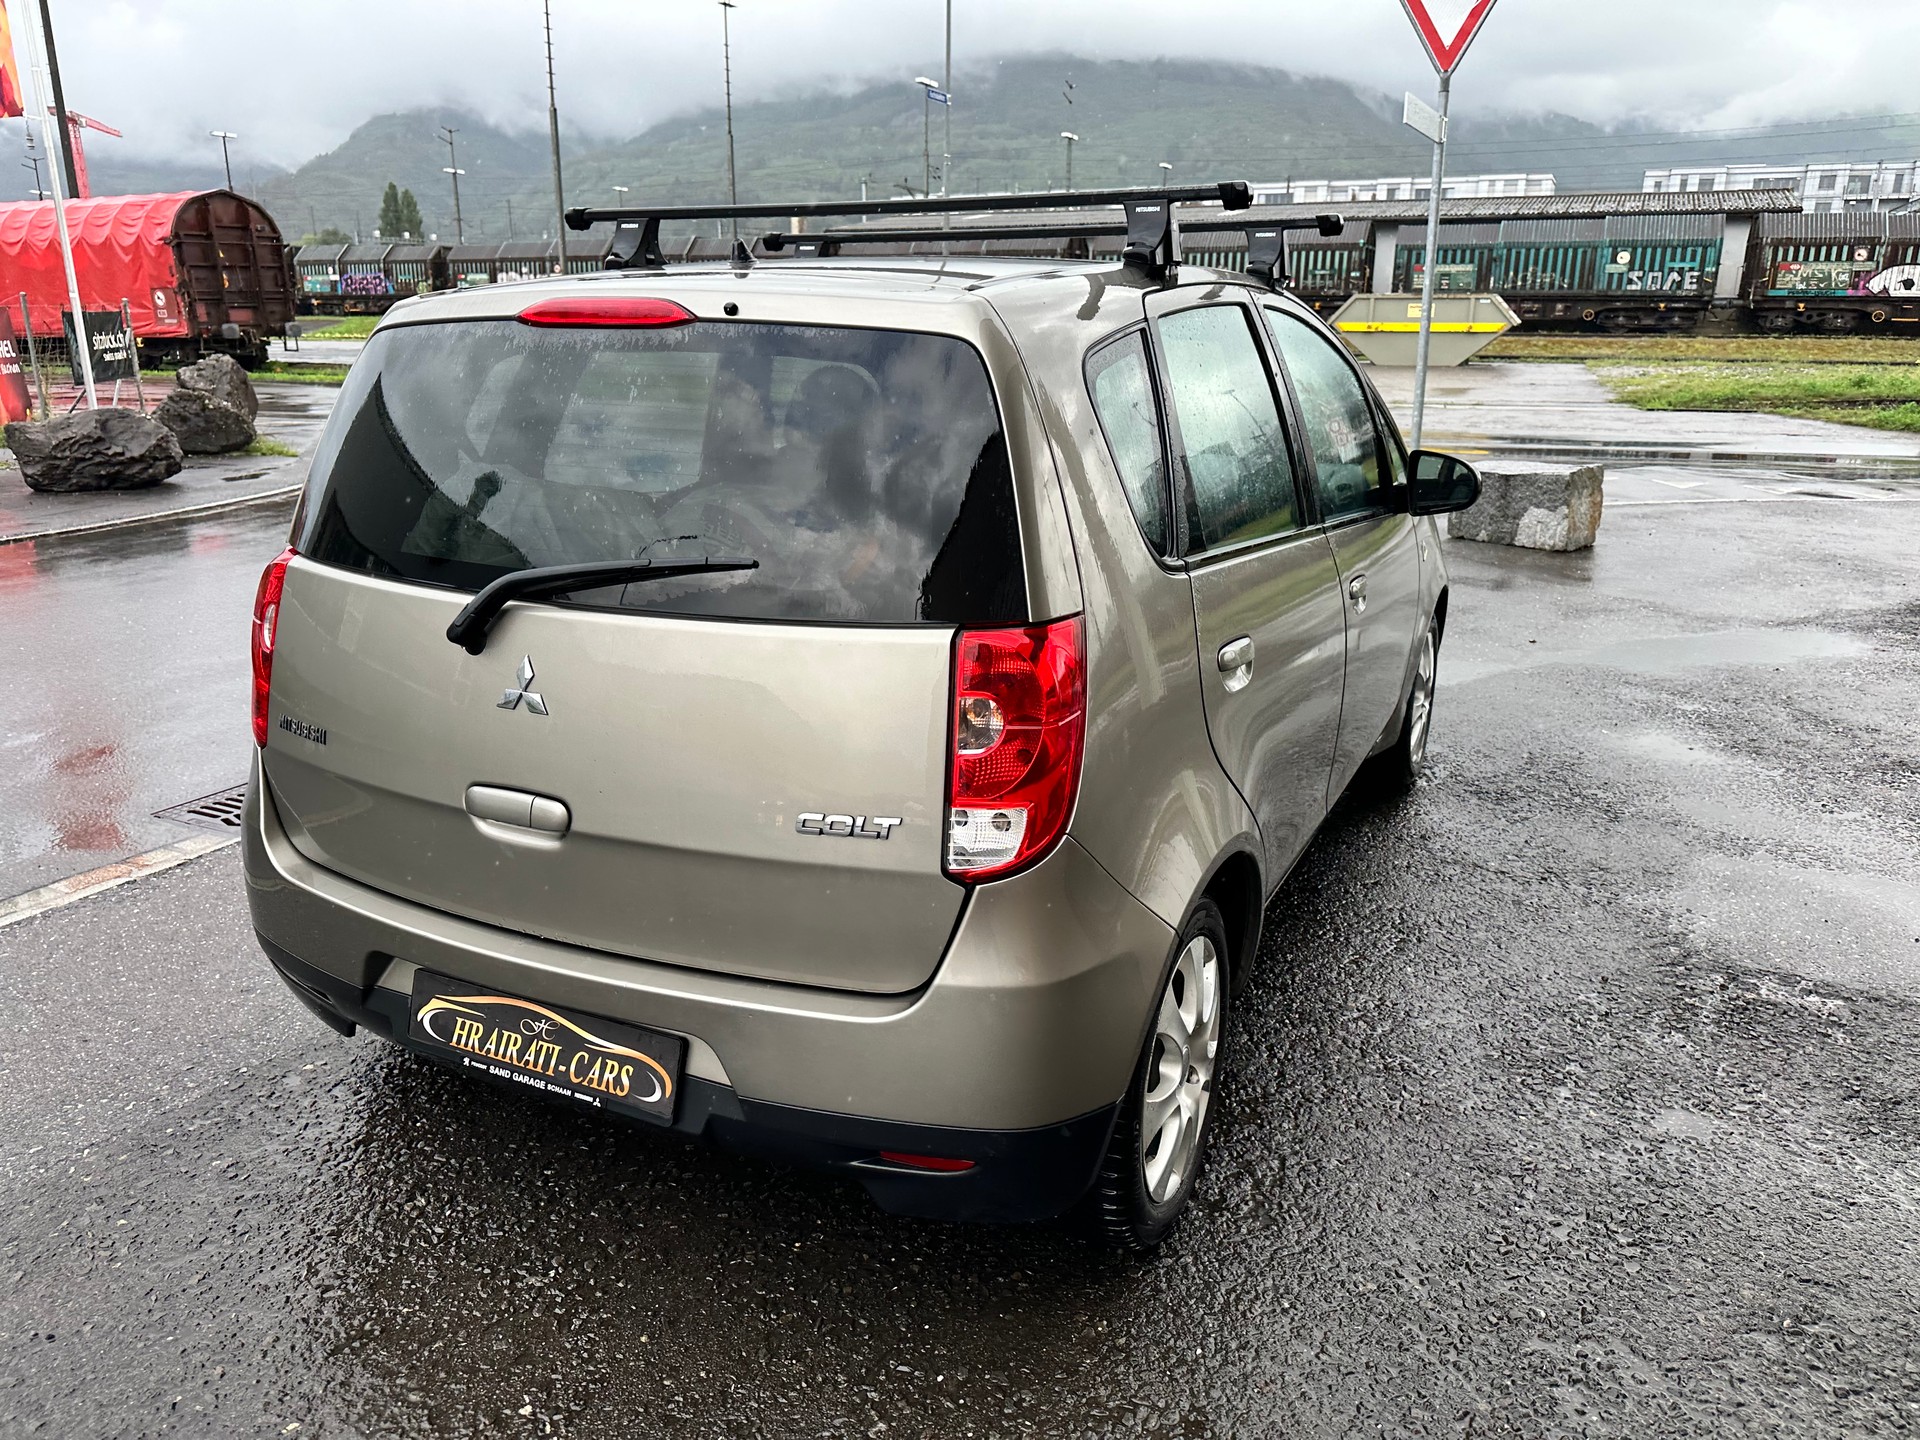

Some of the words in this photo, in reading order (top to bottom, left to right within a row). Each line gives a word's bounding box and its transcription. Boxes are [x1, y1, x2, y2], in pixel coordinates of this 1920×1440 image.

[795, 812, 903, 841] COLT
[489, 1065, 511, 1079] SAND
[512, 1072, 546, 1090] GARAGE
[547, 1083, 572, 1097] SCHAAN
